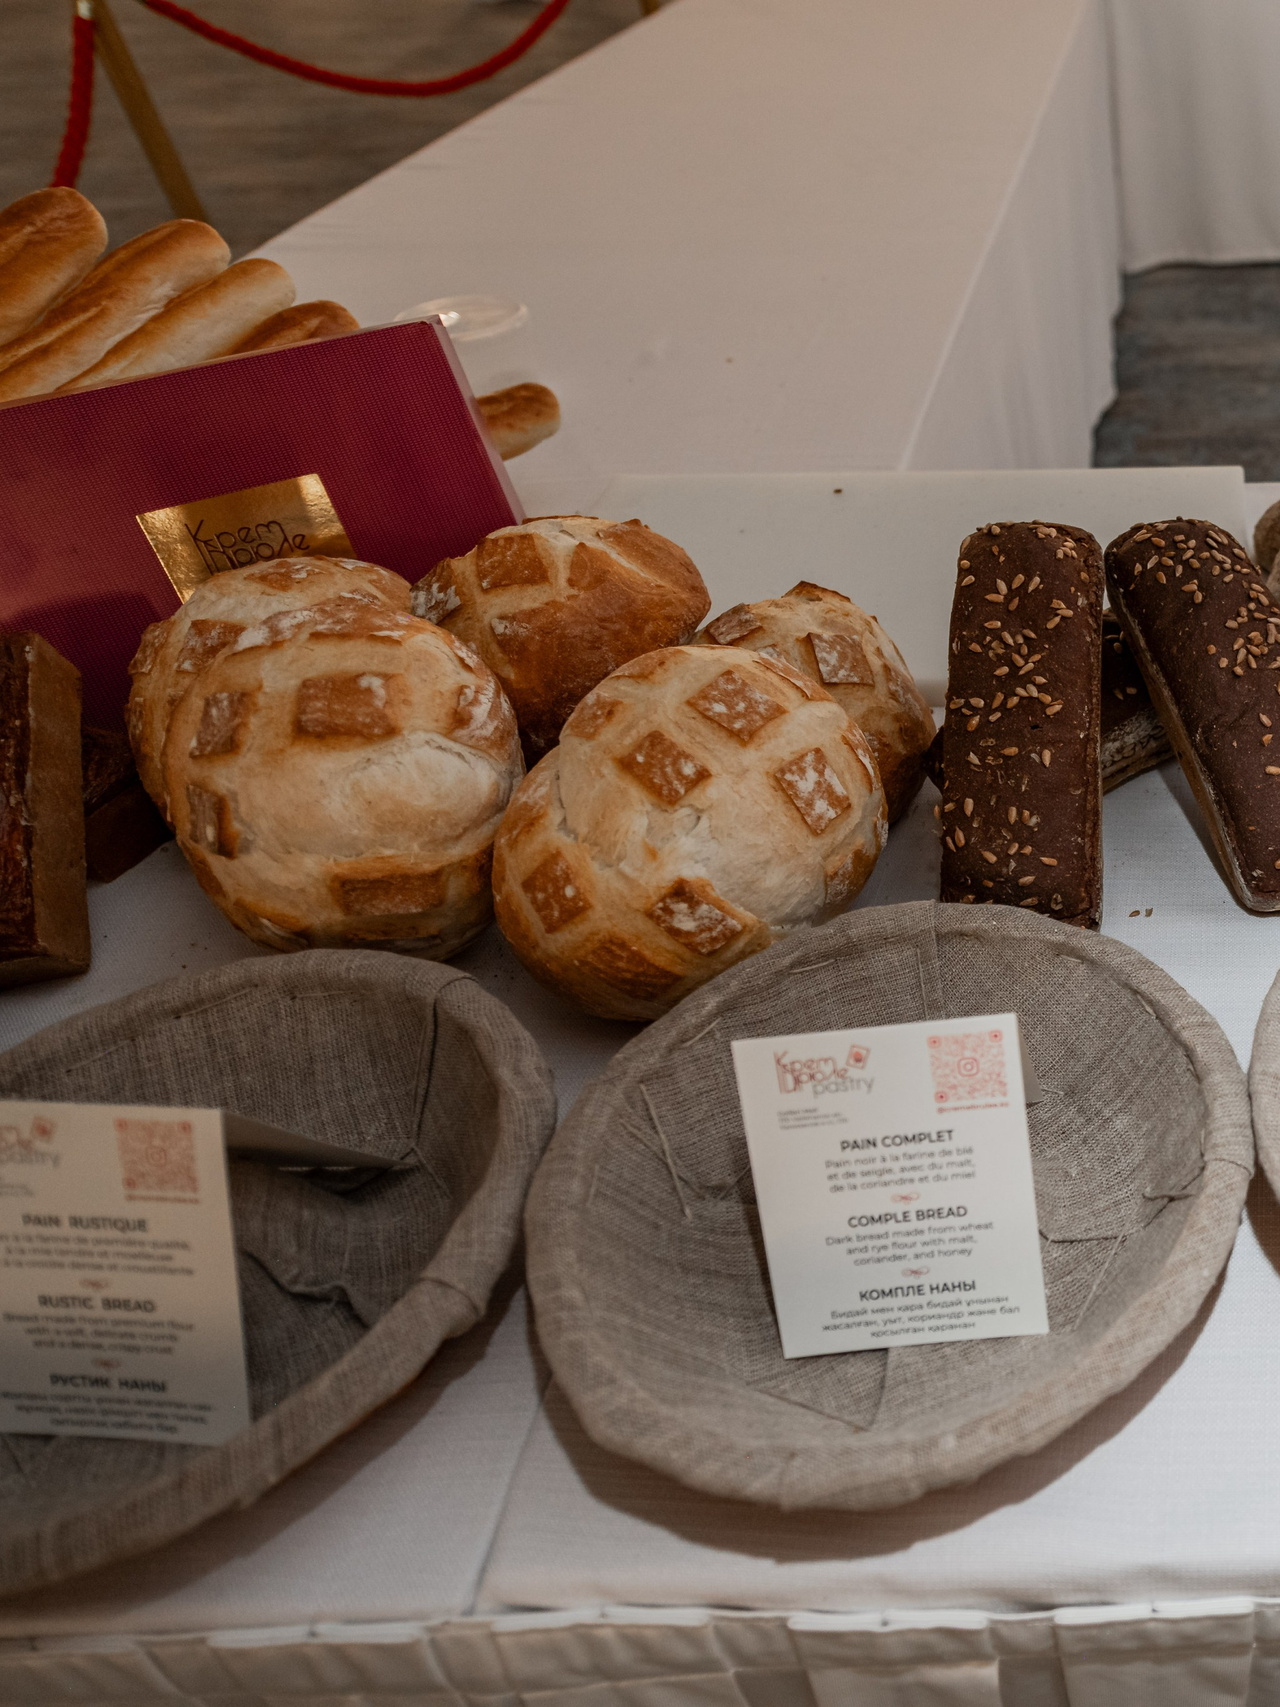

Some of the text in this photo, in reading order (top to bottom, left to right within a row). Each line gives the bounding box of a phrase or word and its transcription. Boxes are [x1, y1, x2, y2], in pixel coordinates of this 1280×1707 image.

[812, 1076, 875, 1098] pastry
[841, 1130, 954, 1152] PAIN COMPLET
[848, 1206, 967, 1228] COMPLE BREAD
[860, 1281, 976, 1302] КОМПЛЕ НАНЫ
